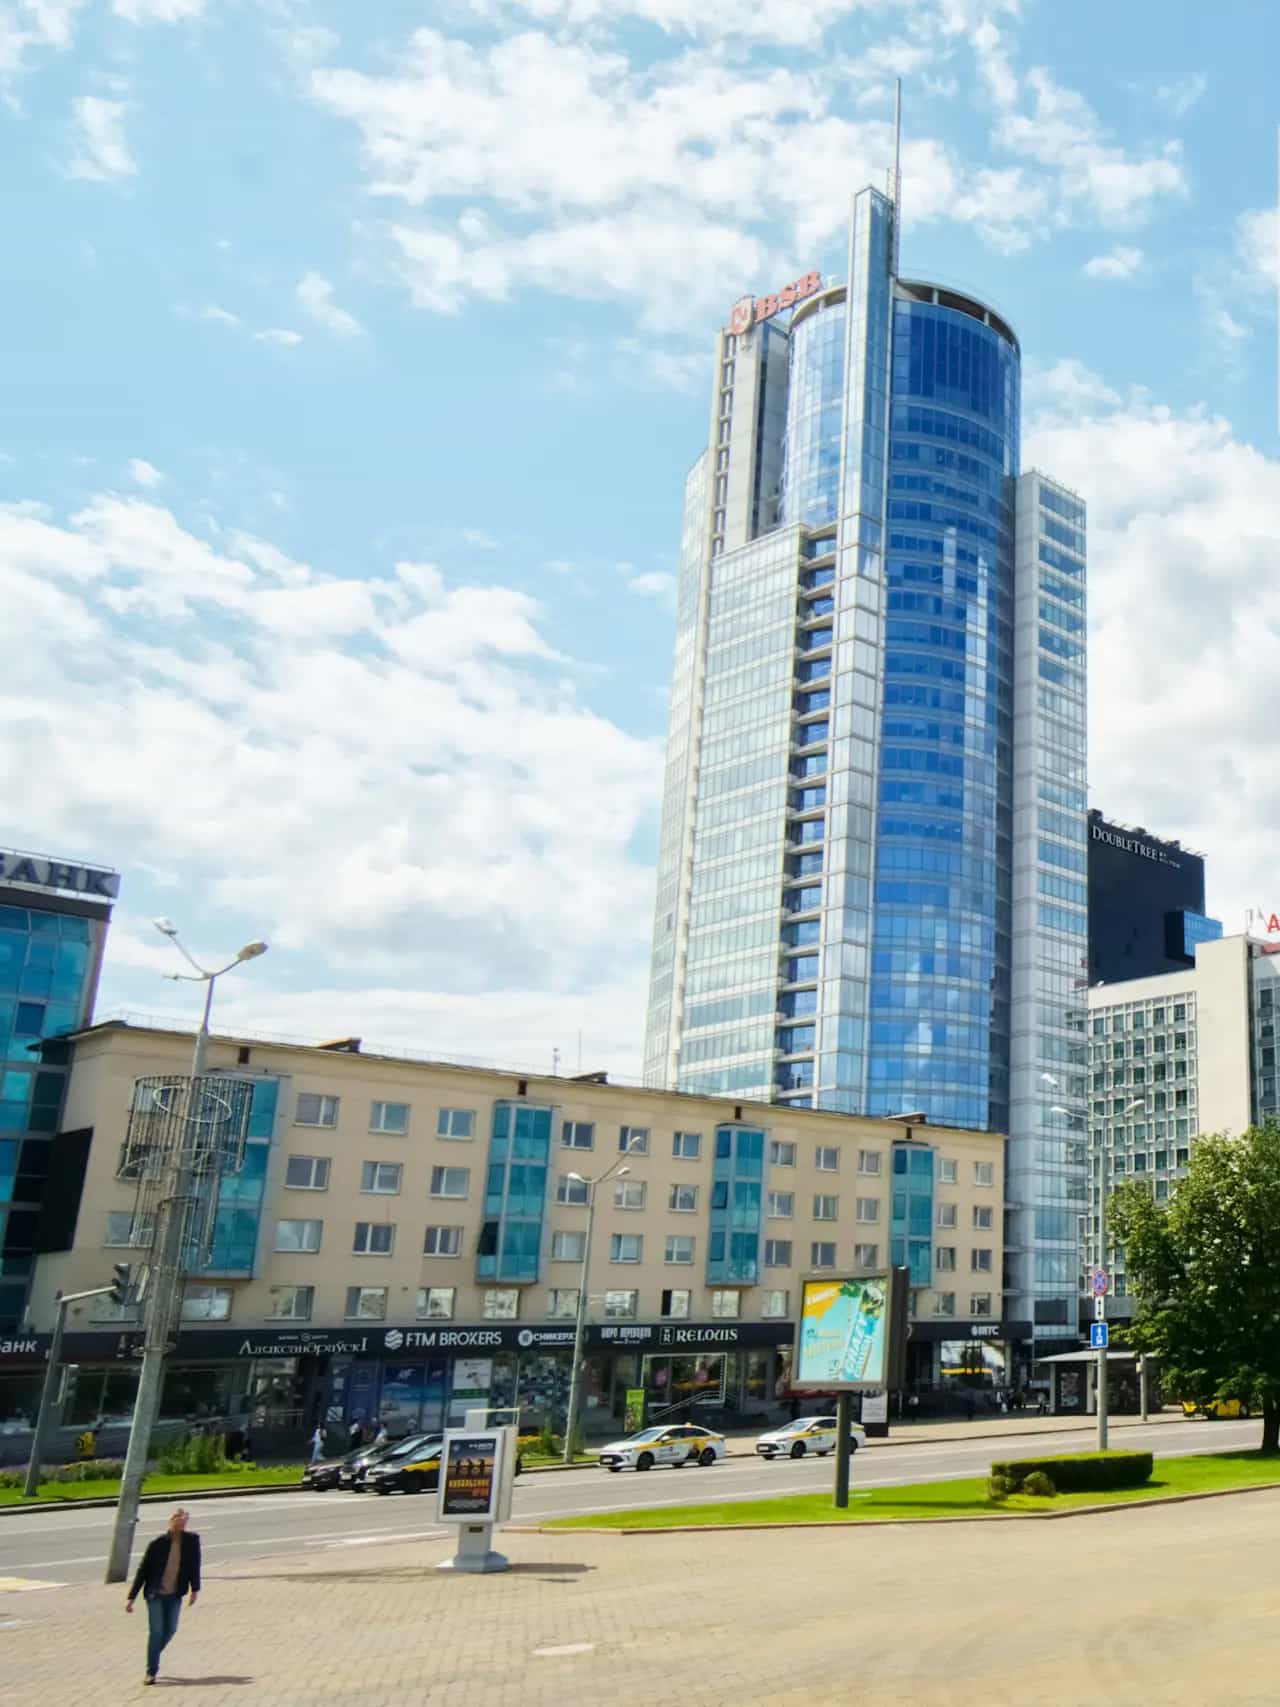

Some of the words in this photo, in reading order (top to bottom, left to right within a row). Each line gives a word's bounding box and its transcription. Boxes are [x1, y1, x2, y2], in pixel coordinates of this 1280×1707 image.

[0, 852, 119, 899] АНК
[0, 1339, 38, 1353] анк
[405, 1332, 436, 1347] FTM
[439, 1331, 503, 1346] BROKERS
